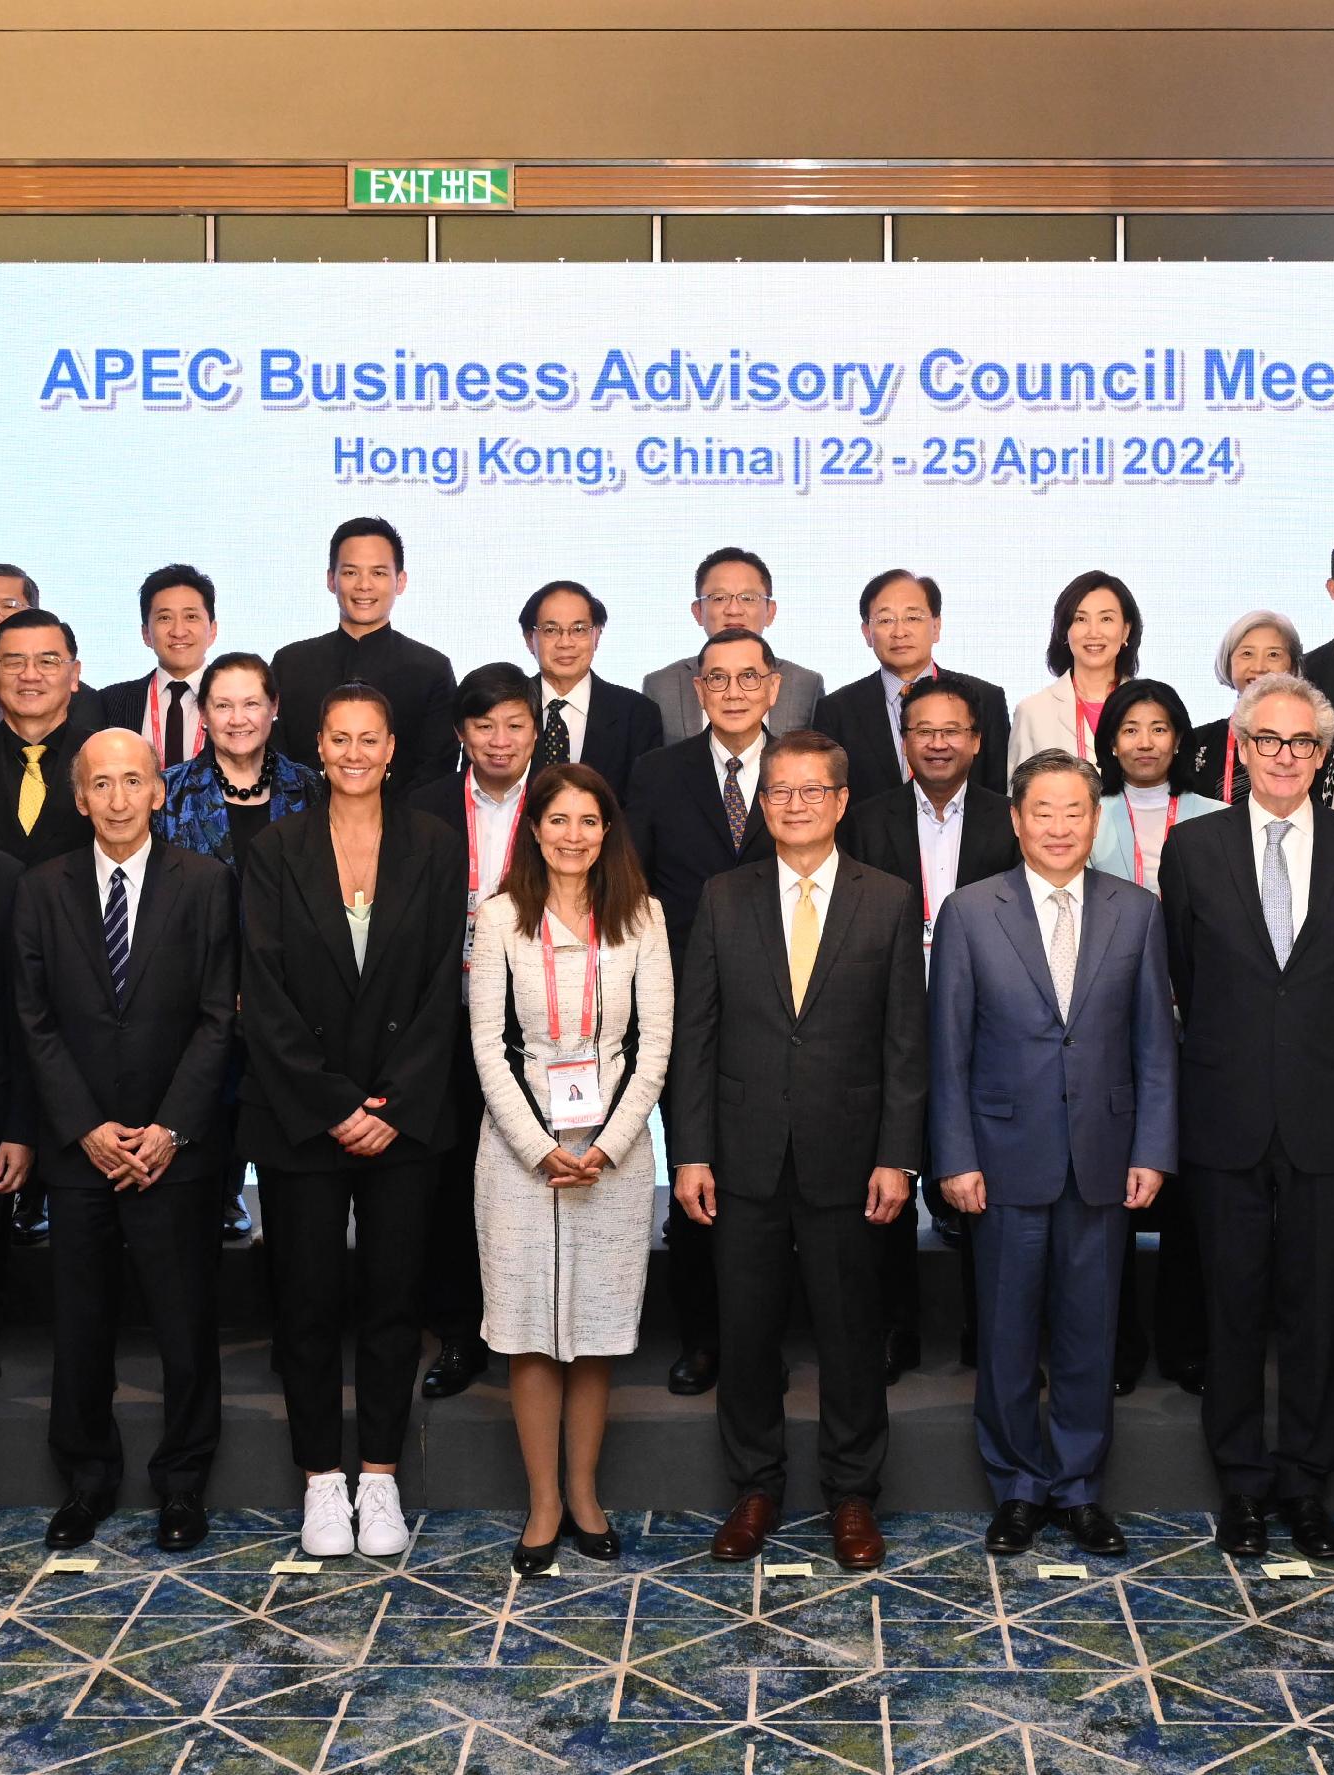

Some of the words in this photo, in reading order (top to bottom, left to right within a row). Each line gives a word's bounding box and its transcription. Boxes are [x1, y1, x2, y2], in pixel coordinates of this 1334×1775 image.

[370, 170, 434, 204] EXIT
[441, 170, 492, 204] 出口
[40, 347, 233, 403] APEC
[260, 347, 571, 404] Business
[591, 348, 896, 416] Advisory
[919, 347, 1177, 403] Council
[334, 436, 459, 486] Hong
[478, 436, 618, 486] Kong,
[635, 436, 774, 476] China
[820, 436, 873, 476] 22
[922, 436, 976, 477] 25
[991, 436, 1105, 485] April
[1123, 436, 1235, 476] 2024
